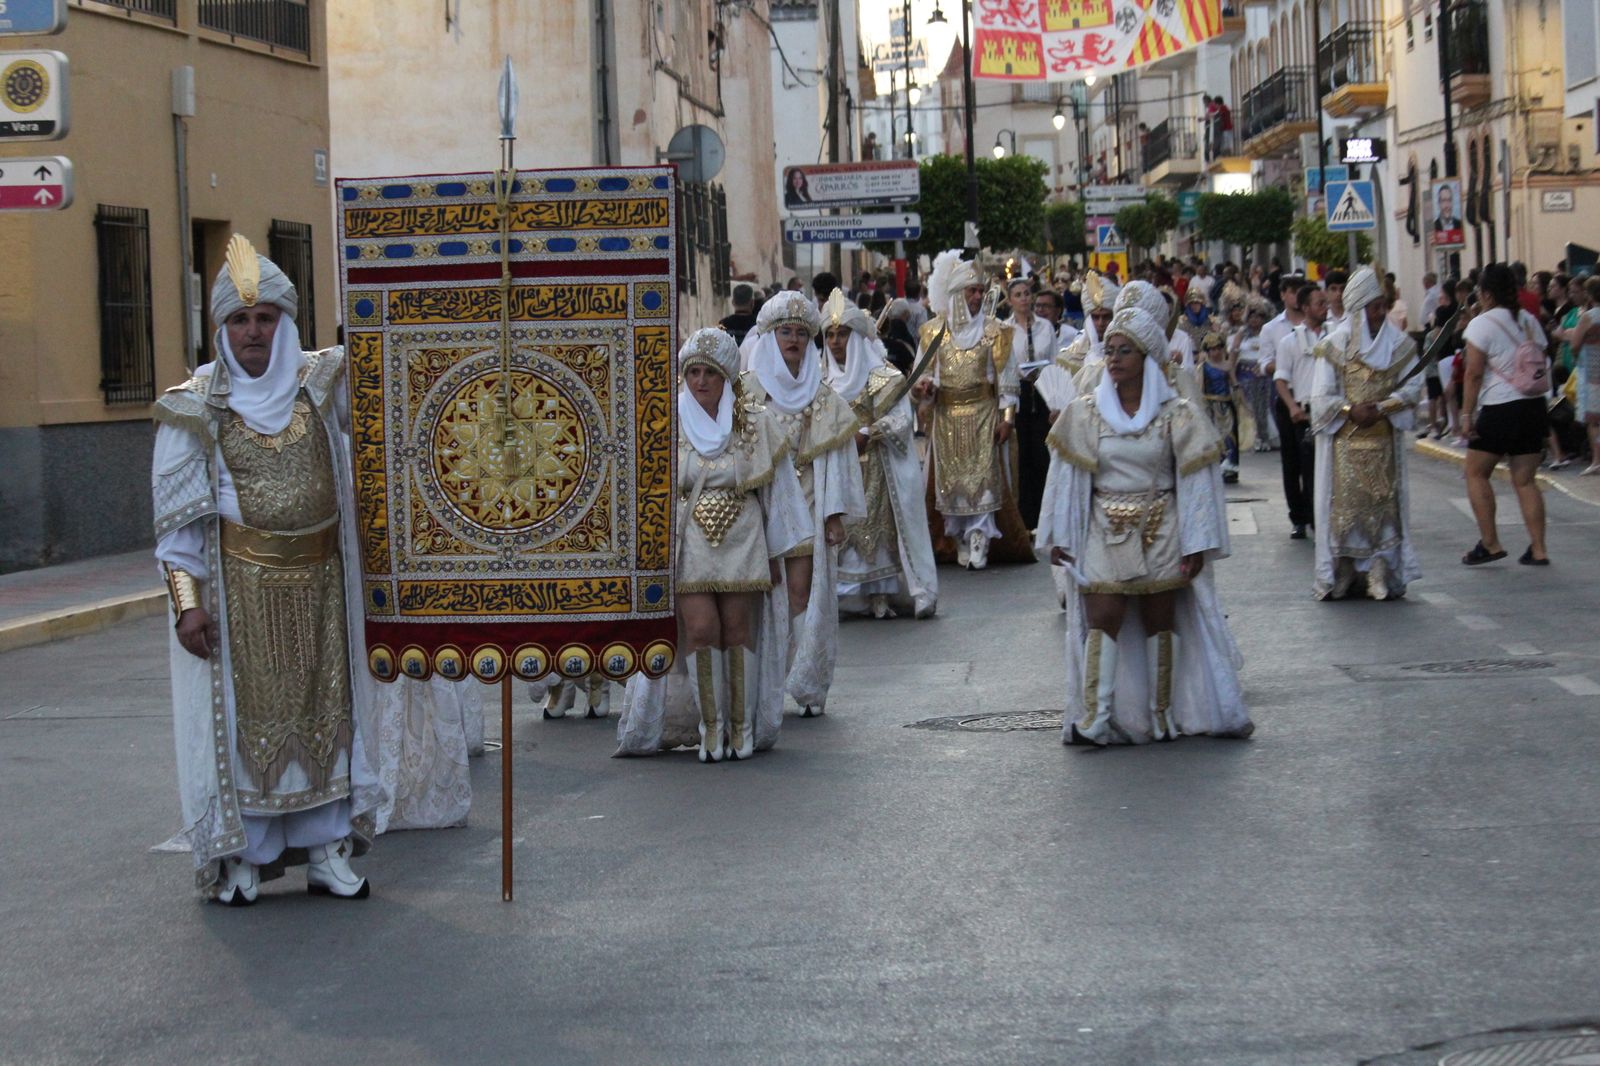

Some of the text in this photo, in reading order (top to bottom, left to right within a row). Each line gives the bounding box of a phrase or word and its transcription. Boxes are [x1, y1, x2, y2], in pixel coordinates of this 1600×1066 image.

[11, 122, 39, 132] Vera
[793, 217, 863, 228] Ayuntamiento
[850, 228, 877, 239] Local
